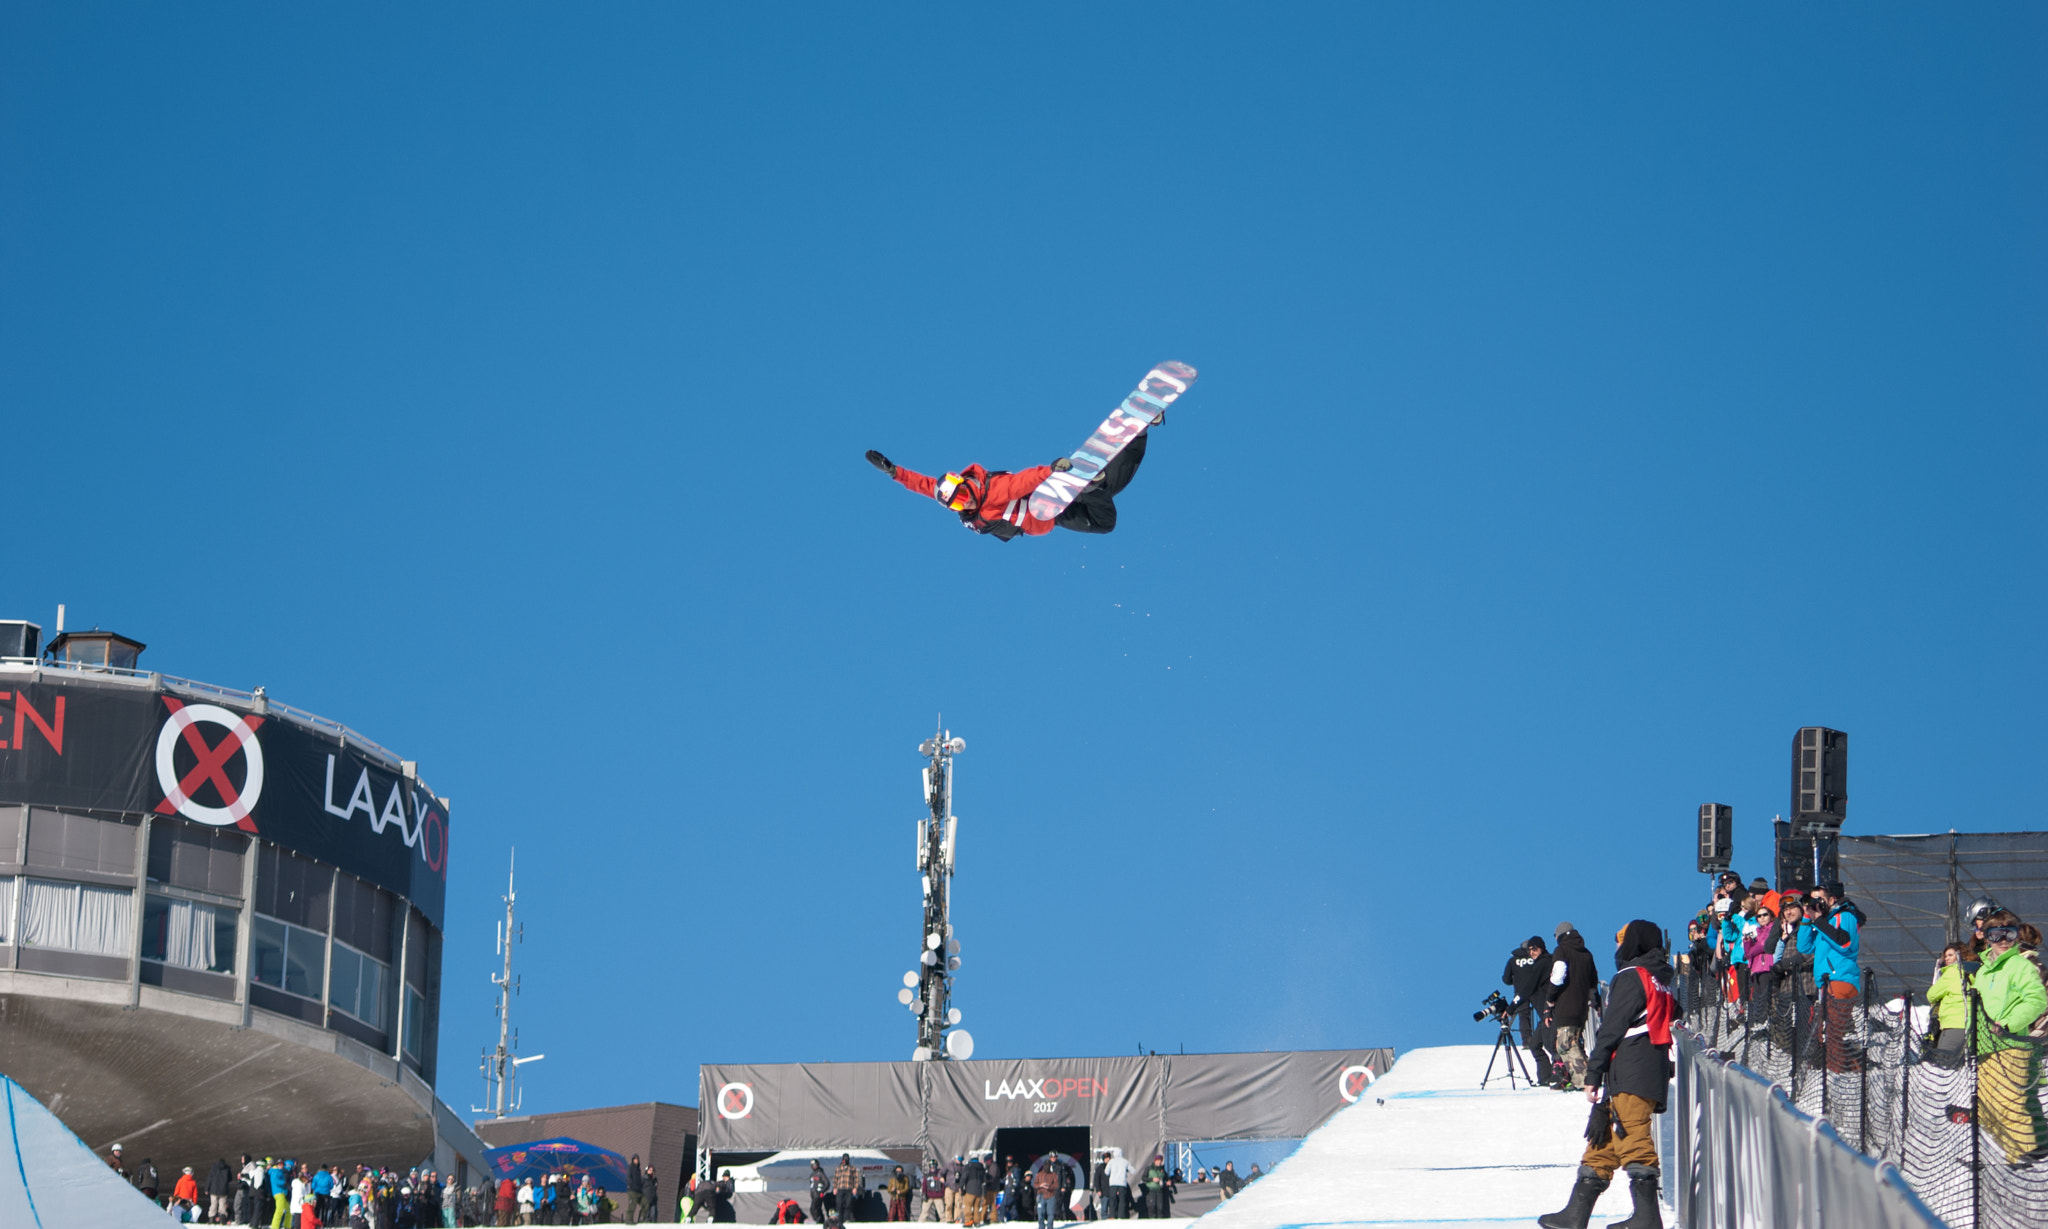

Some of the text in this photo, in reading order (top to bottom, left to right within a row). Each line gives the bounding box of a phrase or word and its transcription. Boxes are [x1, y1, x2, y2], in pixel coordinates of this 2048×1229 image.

[1035, 369, 1187, 503] CUSTOM
[0, 689, 66, 756] N
[985, 1077, 1108, 1100] LAAXOPEN
[1033, 1101, 1058, 1113] 2017
